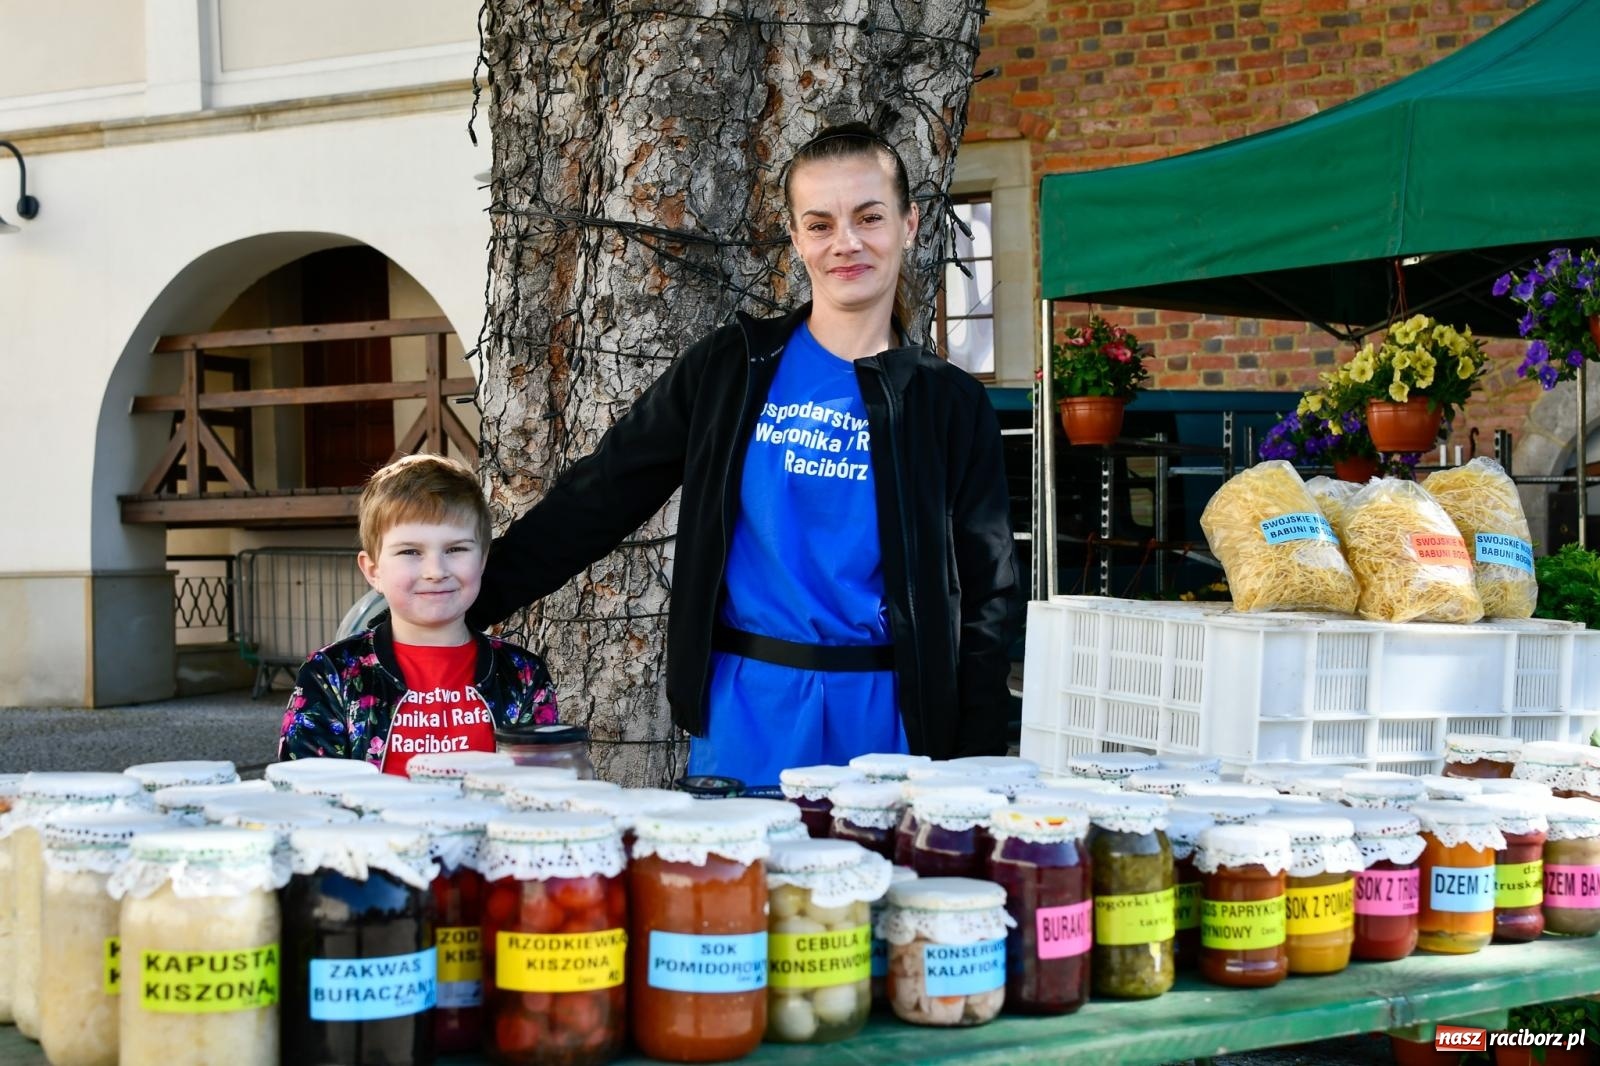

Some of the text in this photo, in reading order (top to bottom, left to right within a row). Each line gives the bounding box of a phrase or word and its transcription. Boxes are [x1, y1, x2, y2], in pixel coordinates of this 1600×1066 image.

[755, 423, 842, 453] Weronika
[856, 431, 870, 451] R
[784, 449, 869, 481] Racibórz
[1262, 515, 1311, 531] SWOJSKIE
[1270, 526, 1307, 539] BABUNI
[1416, 538, 1457, 546] SWOJSKIE
[1476, 535, 1520, 550] SWOJSKIE
[1418, 549, 1451, 558] BABUNI
[1481, 546, 1515, 560] BABUNI
[402, 686, 461, 704] arstwo
[391, 733, 469, 753] Racibórz
[1356, 876, 1382, 901] SOK
[1386, 877, 1393, 901] Z
[1434, 872, 1479, 895] DZEM
[1286, 895, 1310, 920] SOK
[1313, 895, 1320, 918] Z
[700, 943, 737, 955] SOK
[796, 933, 858, 952] CEBULA
[145, 950, 276, 973] KAPUSTA
[329, 958, 422, 979] ZAKWAS
[526, 955, 609, 971] KISZONA
[145, 978, 273, 1001] KISZONA
